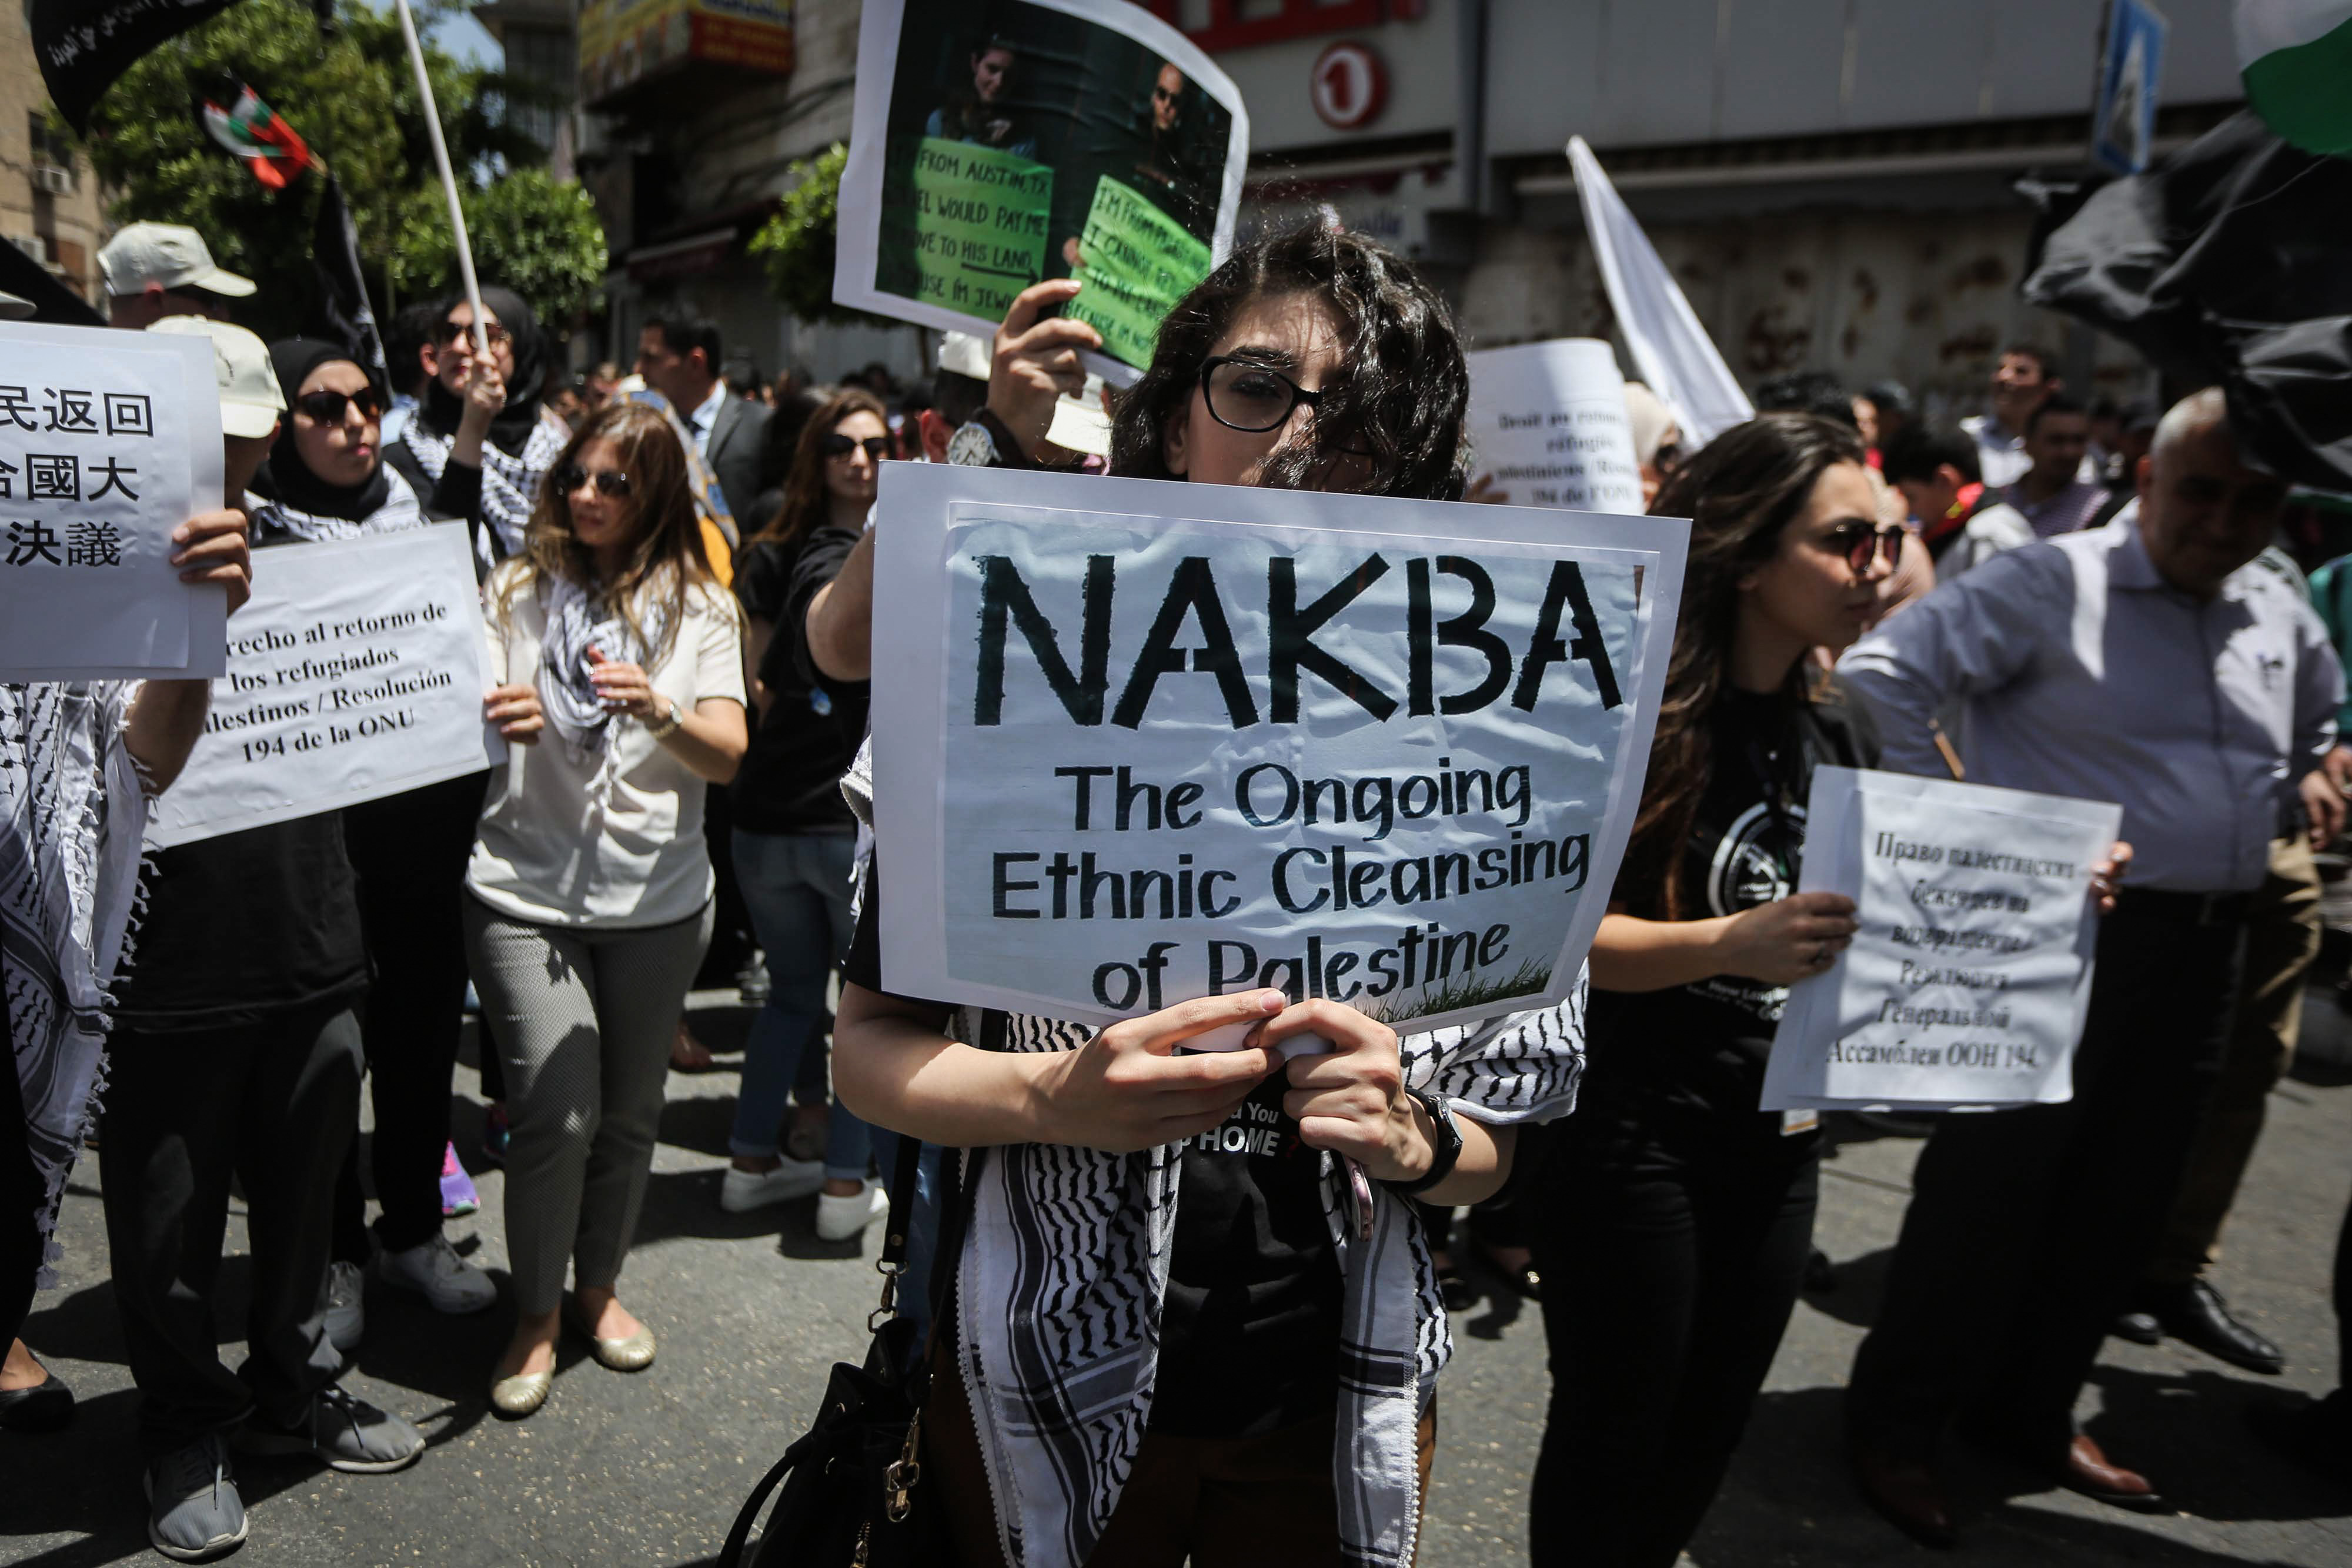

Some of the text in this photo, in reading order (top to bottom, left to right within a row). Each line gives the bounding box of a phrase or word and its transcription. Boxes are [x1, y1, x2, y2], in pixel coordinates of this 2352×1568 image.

[919, 149, 959, 176] FROM
[937, 195, 988, 223] WOULD
[940, 236, 957, 257] TO
[961, 241, 987, 263] HIS
[0, 386, 154, 437] 民返回
[5, 520, 121, 567] 決議
[226, 601, 447, 657] recho al retorno de
[971, 552, 1623, 730] NAKBA
[230, 647, 400, 693] los refugiados
[203, 668, 452, 734] lestinos / Resolución
[242, 707, 415, 763] 194 de la ONU
[1054, 757, 1531, 842] The Ongoing
[1876, 831, 1943, 867] Право
[992, 831, 1590, 920] Ethnic Cleansing
[1093, 921, 1510, 1010] of Palestine
[1946, 1042, 1999, 1068] ООН
[1247, 1101, 1279, 1125] You
[1200, 1126, 1281, 1158] HOME
